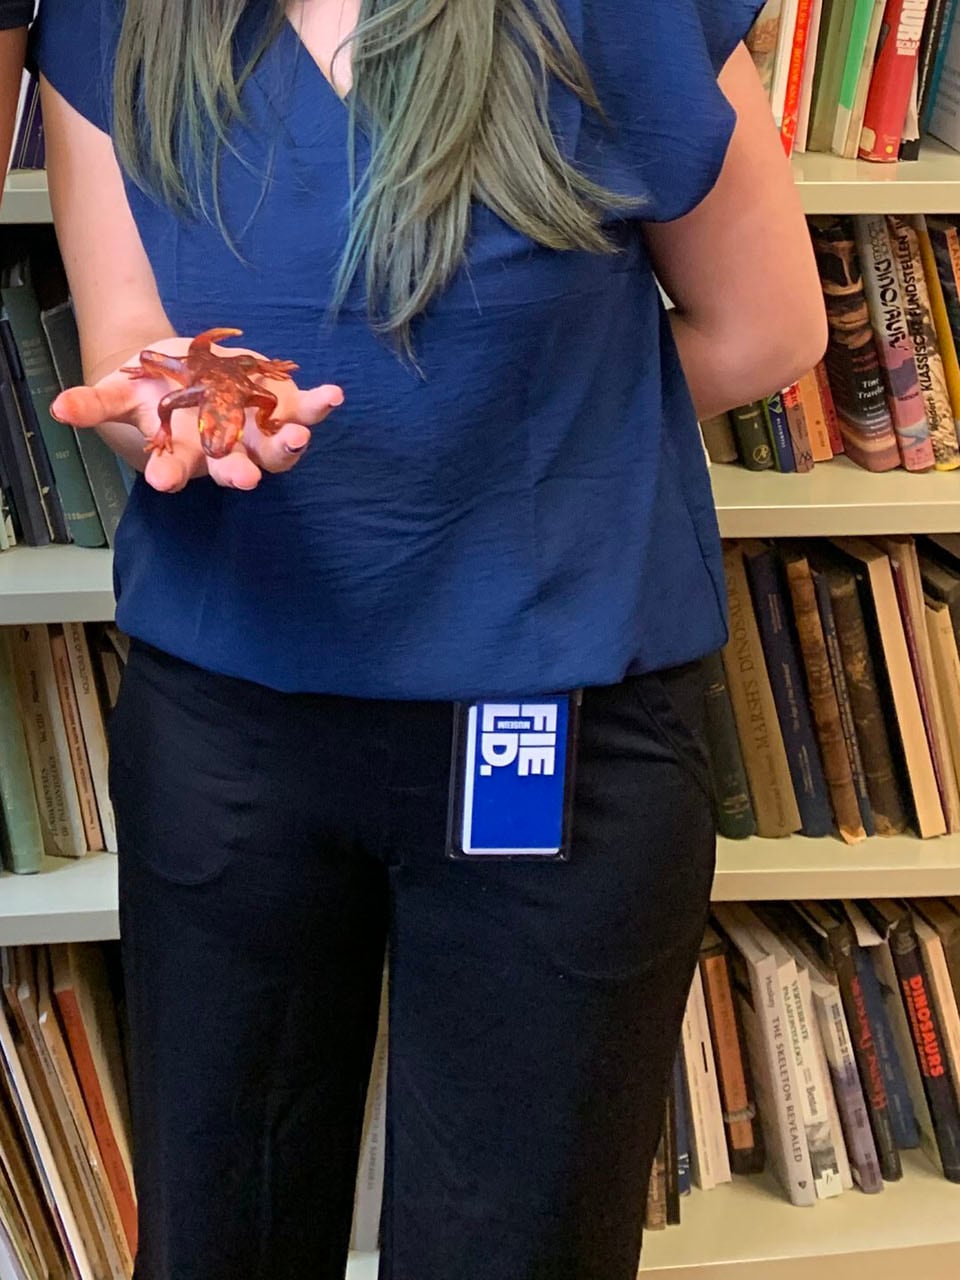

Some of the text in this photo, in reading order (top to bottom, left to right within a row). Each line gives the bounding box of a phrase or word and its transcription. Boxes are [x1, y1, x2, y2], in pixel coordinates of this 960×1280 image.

[897, 234, 933, 392] KLASSISCHE FUNDSTELLEN
[862, 376, 881, 389] Time
[791, 980, 810, 1041] VERTEBRATE
[909, 974, 944, 1077] DINOSAURS
[772, 1016, 802, 1163] THE SKELETON REVEALED
[807, 1085, 818, 1116] Benton
